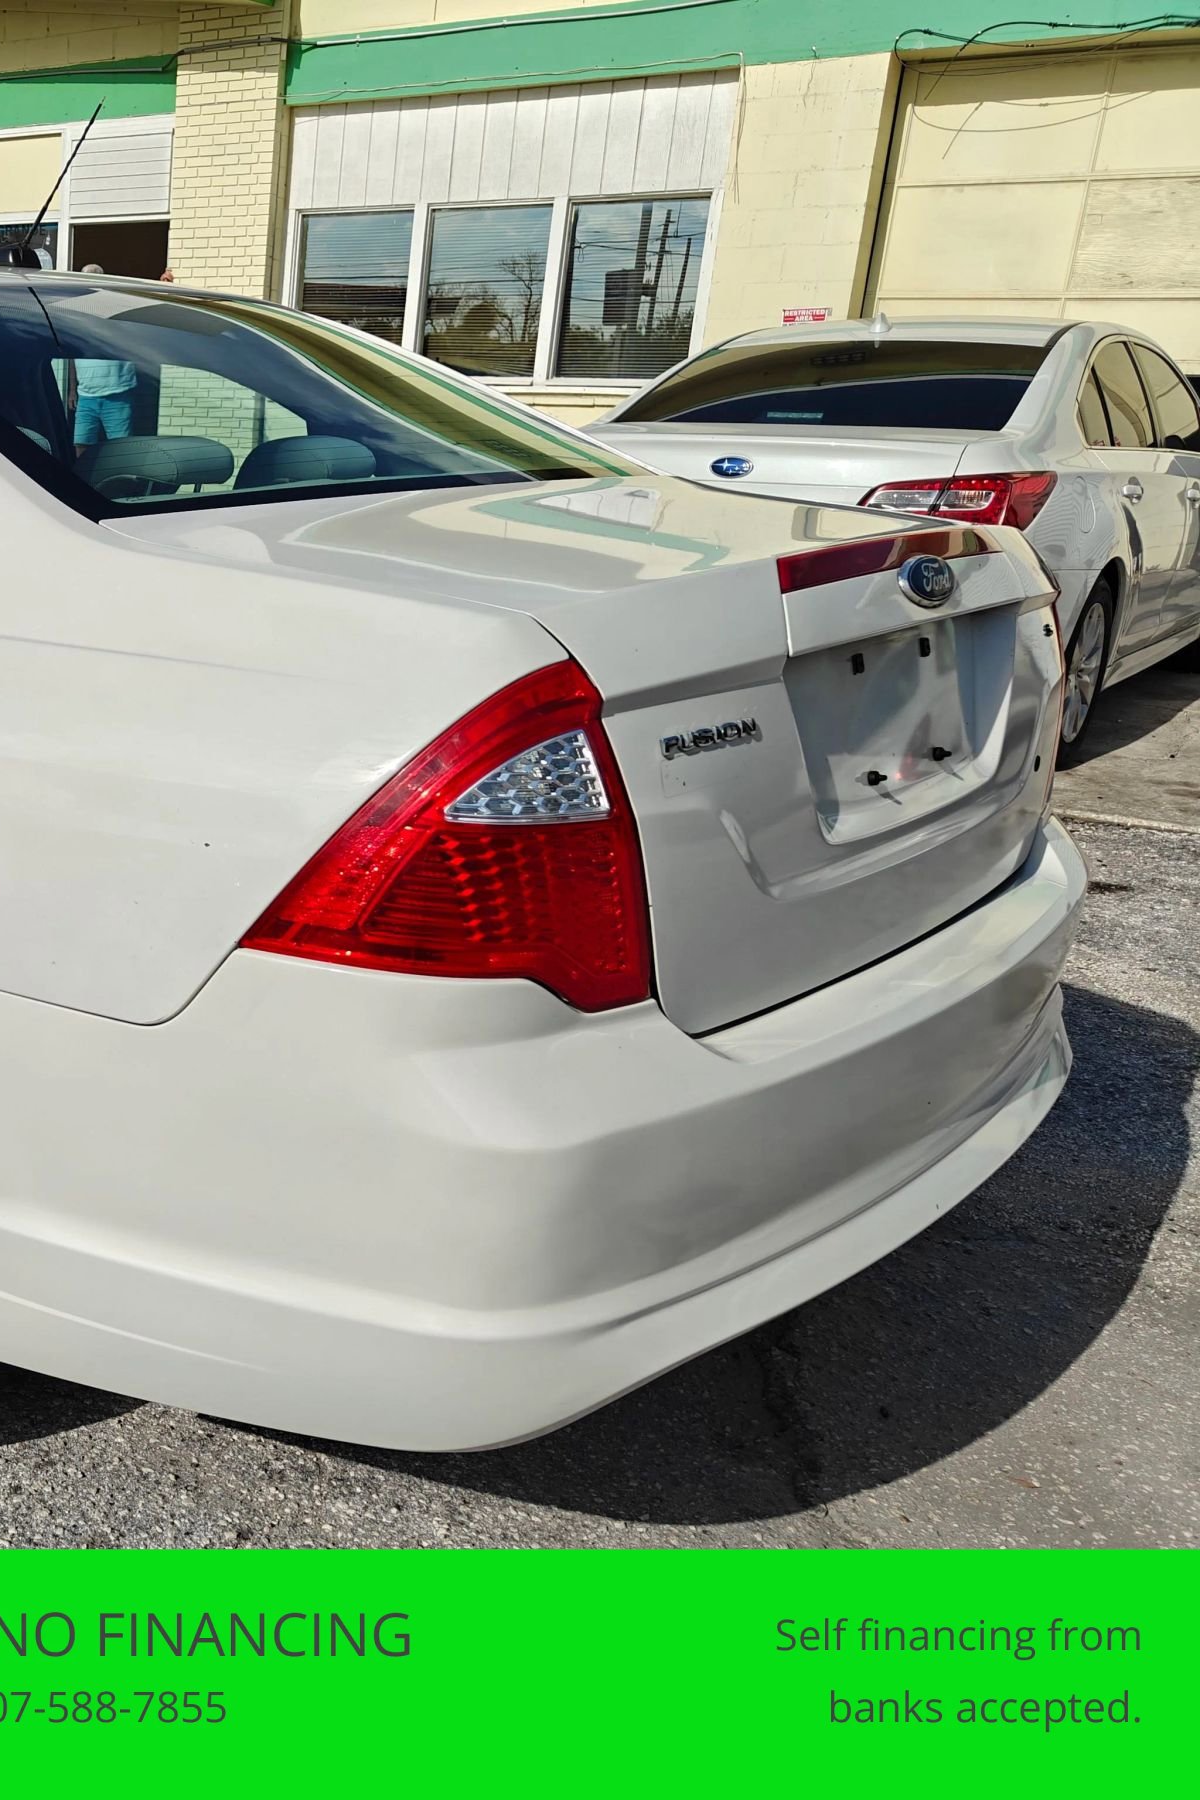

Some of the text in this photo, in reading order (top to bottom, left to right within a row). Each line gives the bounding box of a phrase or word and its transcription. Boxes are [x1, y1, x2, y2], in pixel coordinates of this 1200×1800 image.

[784, 309, 826, 317] RESTRICTED
[921, 562, 952, 592] Ford
[659, 717, 758, 759] FUSION
